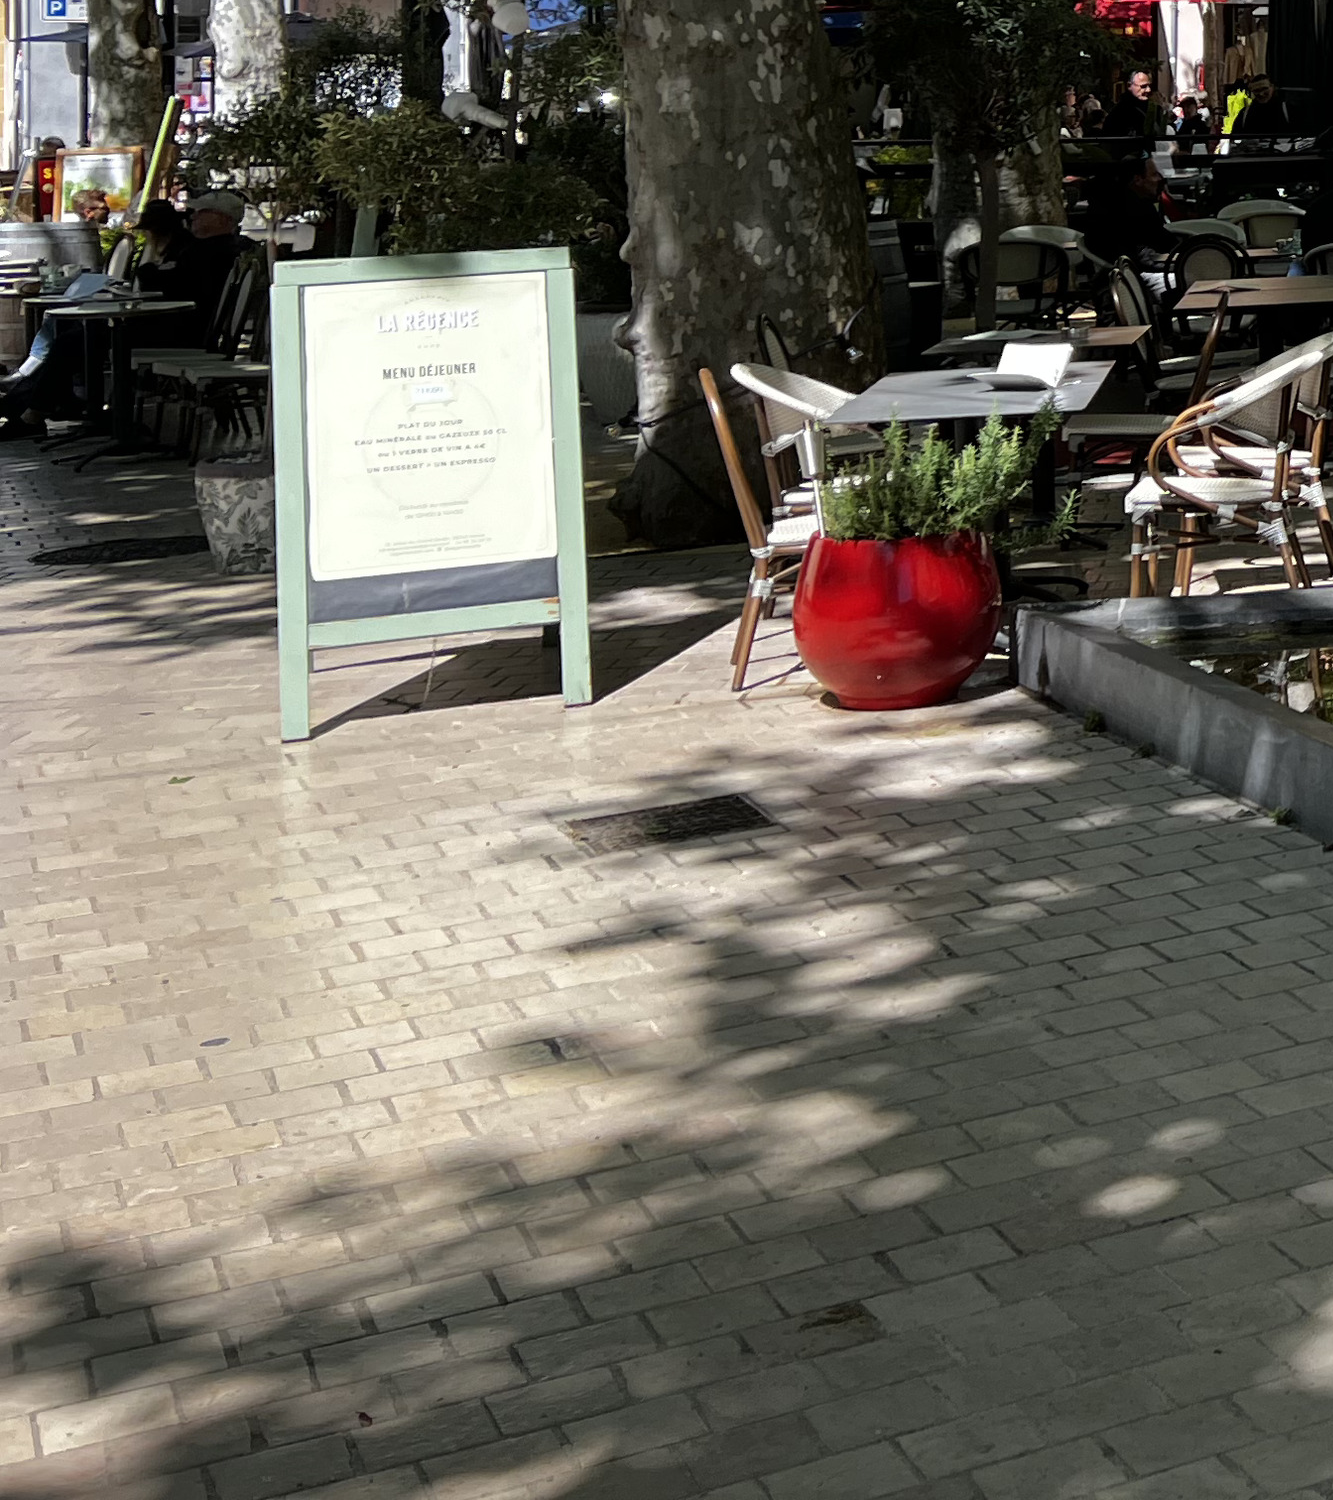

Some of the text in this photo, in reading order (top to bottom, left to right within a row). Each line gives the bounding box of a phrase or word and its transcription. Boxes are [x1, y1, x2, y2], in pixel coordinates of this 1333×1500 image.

[378, 314, 399, 333] LA
[382, 361, 477, 380] MENU DÉJEUNER
[397, 418, 464, 430] PLAT DU JOUR
[383, 462, 425, 473] DESSERT
